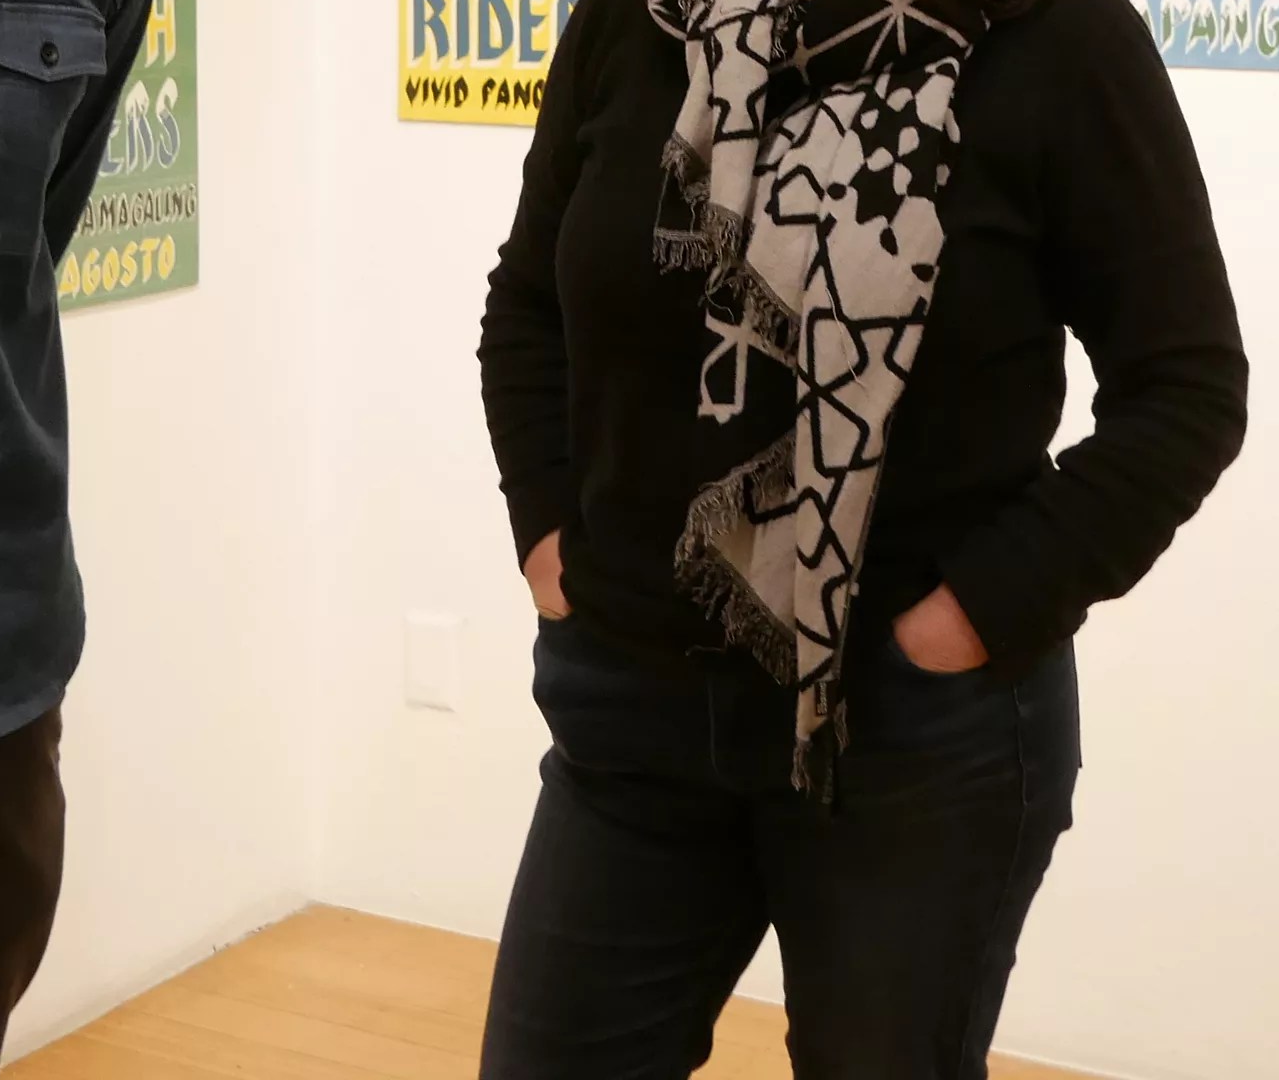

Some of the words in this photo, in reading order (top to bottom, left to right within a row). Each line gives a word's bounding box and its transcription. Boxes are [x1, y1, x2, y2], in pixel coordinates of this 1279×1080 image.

[405, 74, 469, 108] VIVID
[98, 183, 197, 234] MAGALING
[57, 233, 176, 299] AGOSTO
